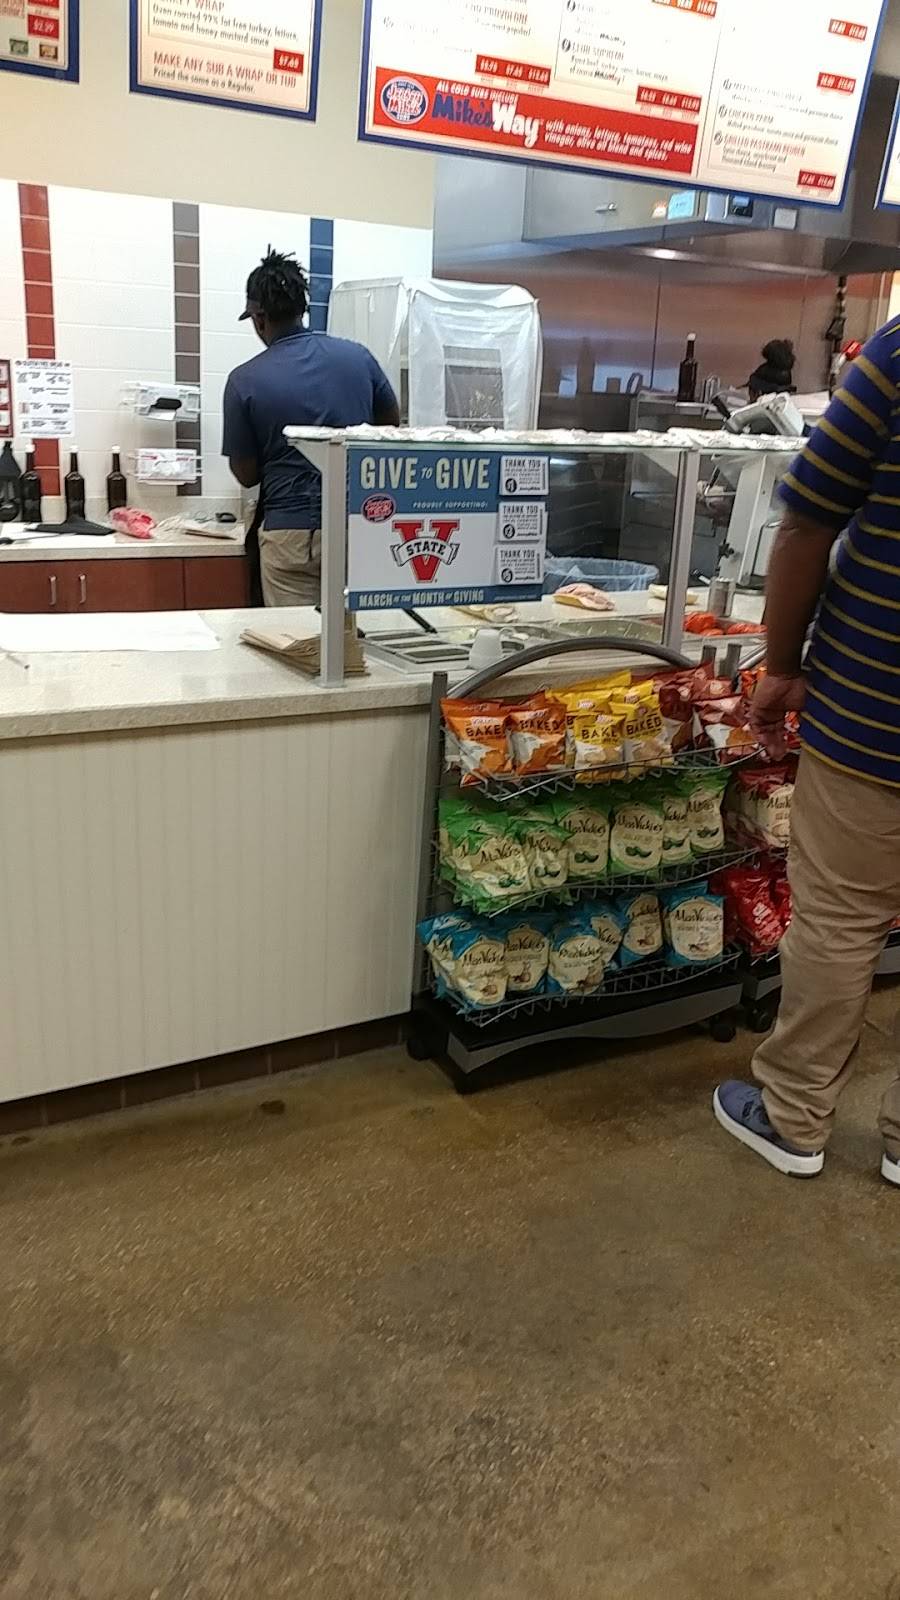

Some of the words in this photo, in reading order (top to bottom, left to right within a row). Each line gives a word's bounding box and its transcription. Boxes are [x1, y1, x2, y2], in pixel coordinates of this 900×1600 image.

[153, 50, 182, 68] MAKE
[184, 55, 204, 72] ANY
[206, 61, 225, 76] SUB
[226, 65, 233, 77] A
[235, 66, 264, 83] WRAP
[436, 80, 450, 93] ALL
[450, 83, 470, 96] COLD
[471, 86, 489, 99] SUBS
[432, 93, 493, 129] Mike's
[492, 101, 541, 149] Way
[545, 119, 564, 132] with
[565, 123, 592, 139] onions,
[594, 126, 621, 142] lettuce,
[660, 138, 673, 150] red
[674, 141, 692, 155] wine
[576, 136, 596, 150] olive
[596, 139, 607, 151] oil
[608, 141, 628, 155] blend
[629, 144, 644, 157] and
[505, 459, 525, 468] THANK
[528, 459, 541, 468] YOU
[360, 455, 418, 490] GIVE
[420, 466, 433, 480] TO
[434, 455, 491, 490] GIVE
[412, 501, 443, 509] PROUDLY
[503, 505, 524, 514] THANK
[526, 505, 538, 514] YOU
[405, 541, 446, 557] STATE
[500, 549, 521, 559] THANK
[523, 549, 535, 558] YOU
[359, 593, 393, 608] MARCH
[412, 591, 445, 606] MONTH
[453, 590, 485, 604] GIVING
[465, 723, 506, 738] BAKE
[519, 718, 562, 733] BAKED
[581, 726, 618, 740] BAKE
[627, 717, 662, 735] BAKED
